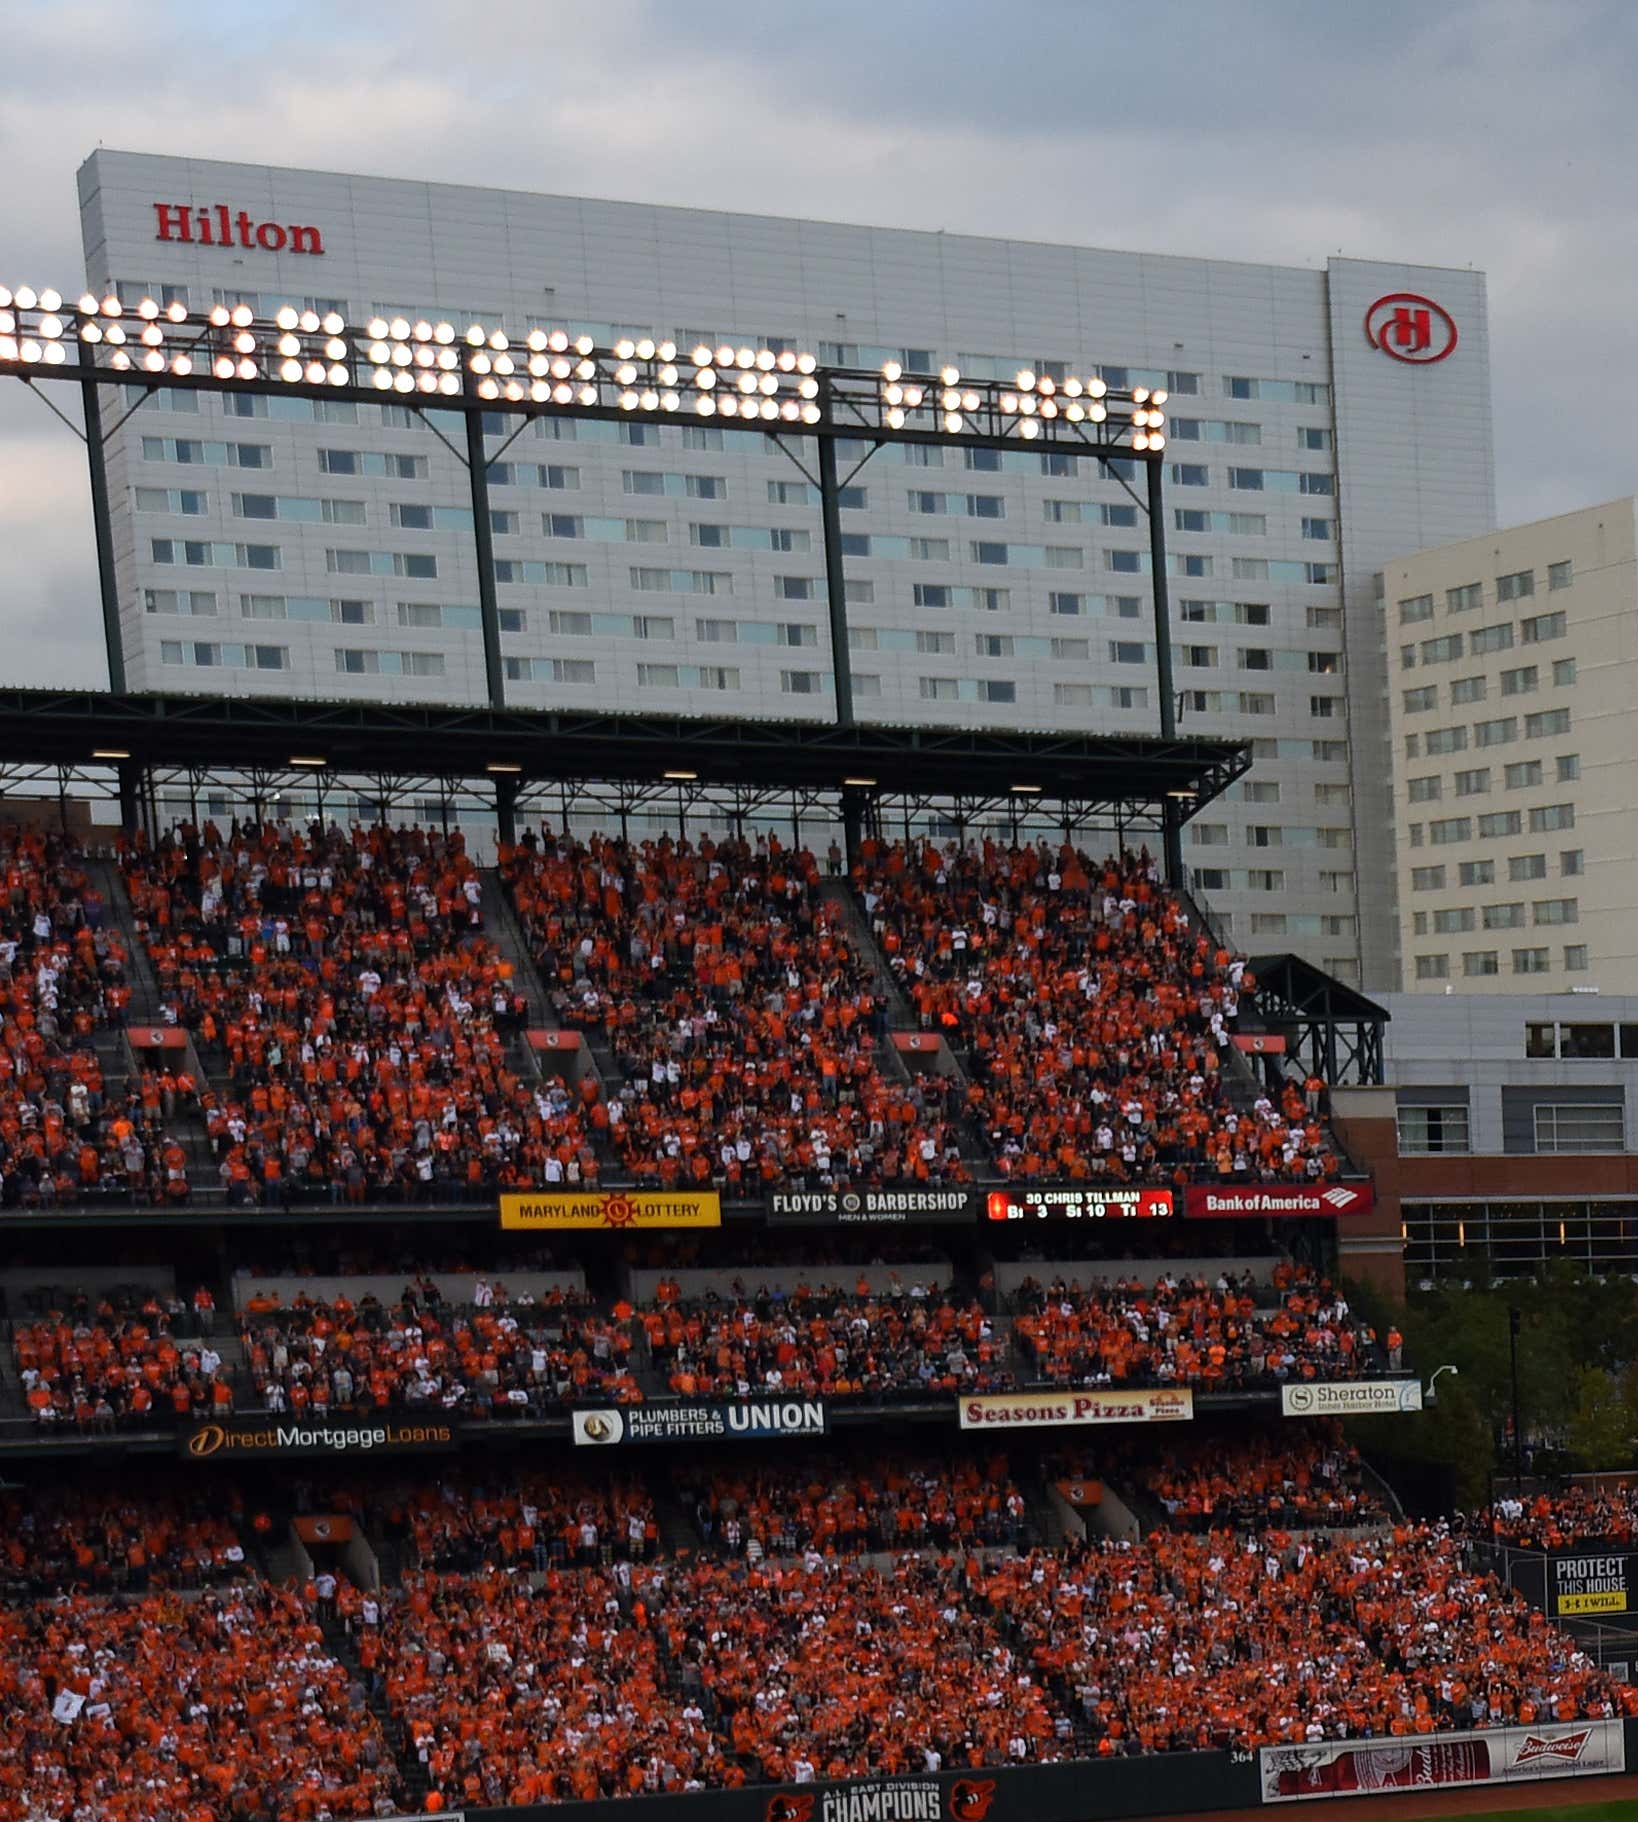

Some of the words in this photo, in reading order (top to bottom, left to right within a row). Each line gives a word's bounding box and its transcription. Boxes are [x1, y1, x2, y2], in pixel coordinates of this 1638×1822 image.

[153, 203, 326, 255] Hilton
[772, 1194, 838, 1213] FLOYD'S
[866, 1192, 969, 1211] BARBERSHOP
[1025, 1192, 1042, 1205] 30
[1044, 1192, 1083, 1204] CHRIS
[1085, 1191, 1141, 1204] TILLMAN
[1206, 1194, 1245, 1211] Bank
[1245, 1194, 1261, 1210] of
[1261, 1193, 1321, 1210] America
[520, 1205, 601, 1219] MARYLAND
[636, 1203, 701, 1217] LOTTERY
[1086, 1204, 1106, 1218] 10
[1148, 1203, 1169, 1216] 13
[1317, 1385, 1397, 1402] Sheraton
[629, 1407, 709, 1424] PLUMBERS
[712, 1409, 721, 1421] &
[728, 1402, 825, 1431] UNION
[966, 1401, 1068, 1423] Seasons
[1072, 1397, 1146, 1420] Pizza
[630, 1423, 665, 1438] PIPE
[667, 1421, 725, 1437] FITTERS
[1556, 1557, 1625, 1580] PROTECT
[1557, 1579, 1584, 1595] THIS
[1586, 1577, 1629, 1593] HOUSE.
[1230, 1750, 1254, 1764] 364
[850, 1783, 882, 1795] EAST
[886, 1781, 940, 1791] DIVISION
